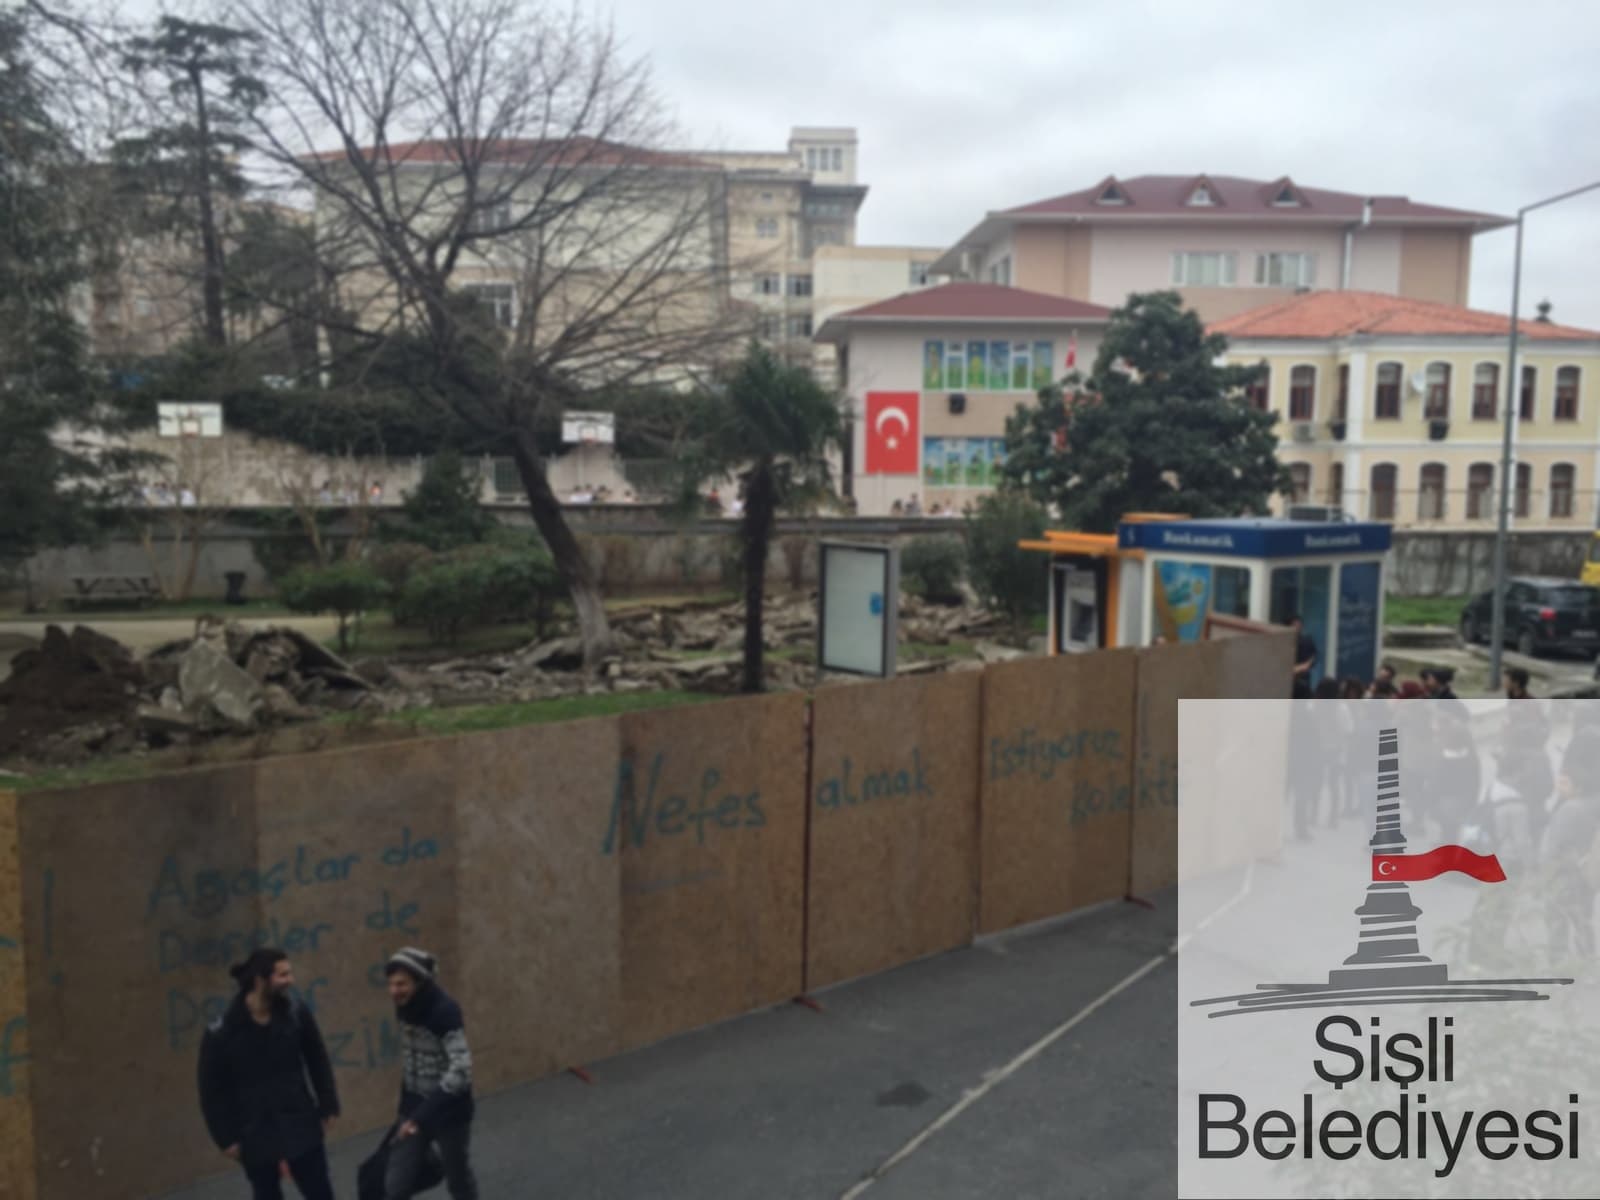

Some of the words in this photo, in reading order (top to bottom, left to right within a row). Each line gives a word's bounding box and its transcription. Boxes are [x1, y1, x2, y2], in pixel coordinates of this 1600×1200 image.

[601, 751, 767, 856] Nefes
[815, 748, 934, 809] almak
[380, 826, 440, 866] da
[365, 889, 422, 936] de
